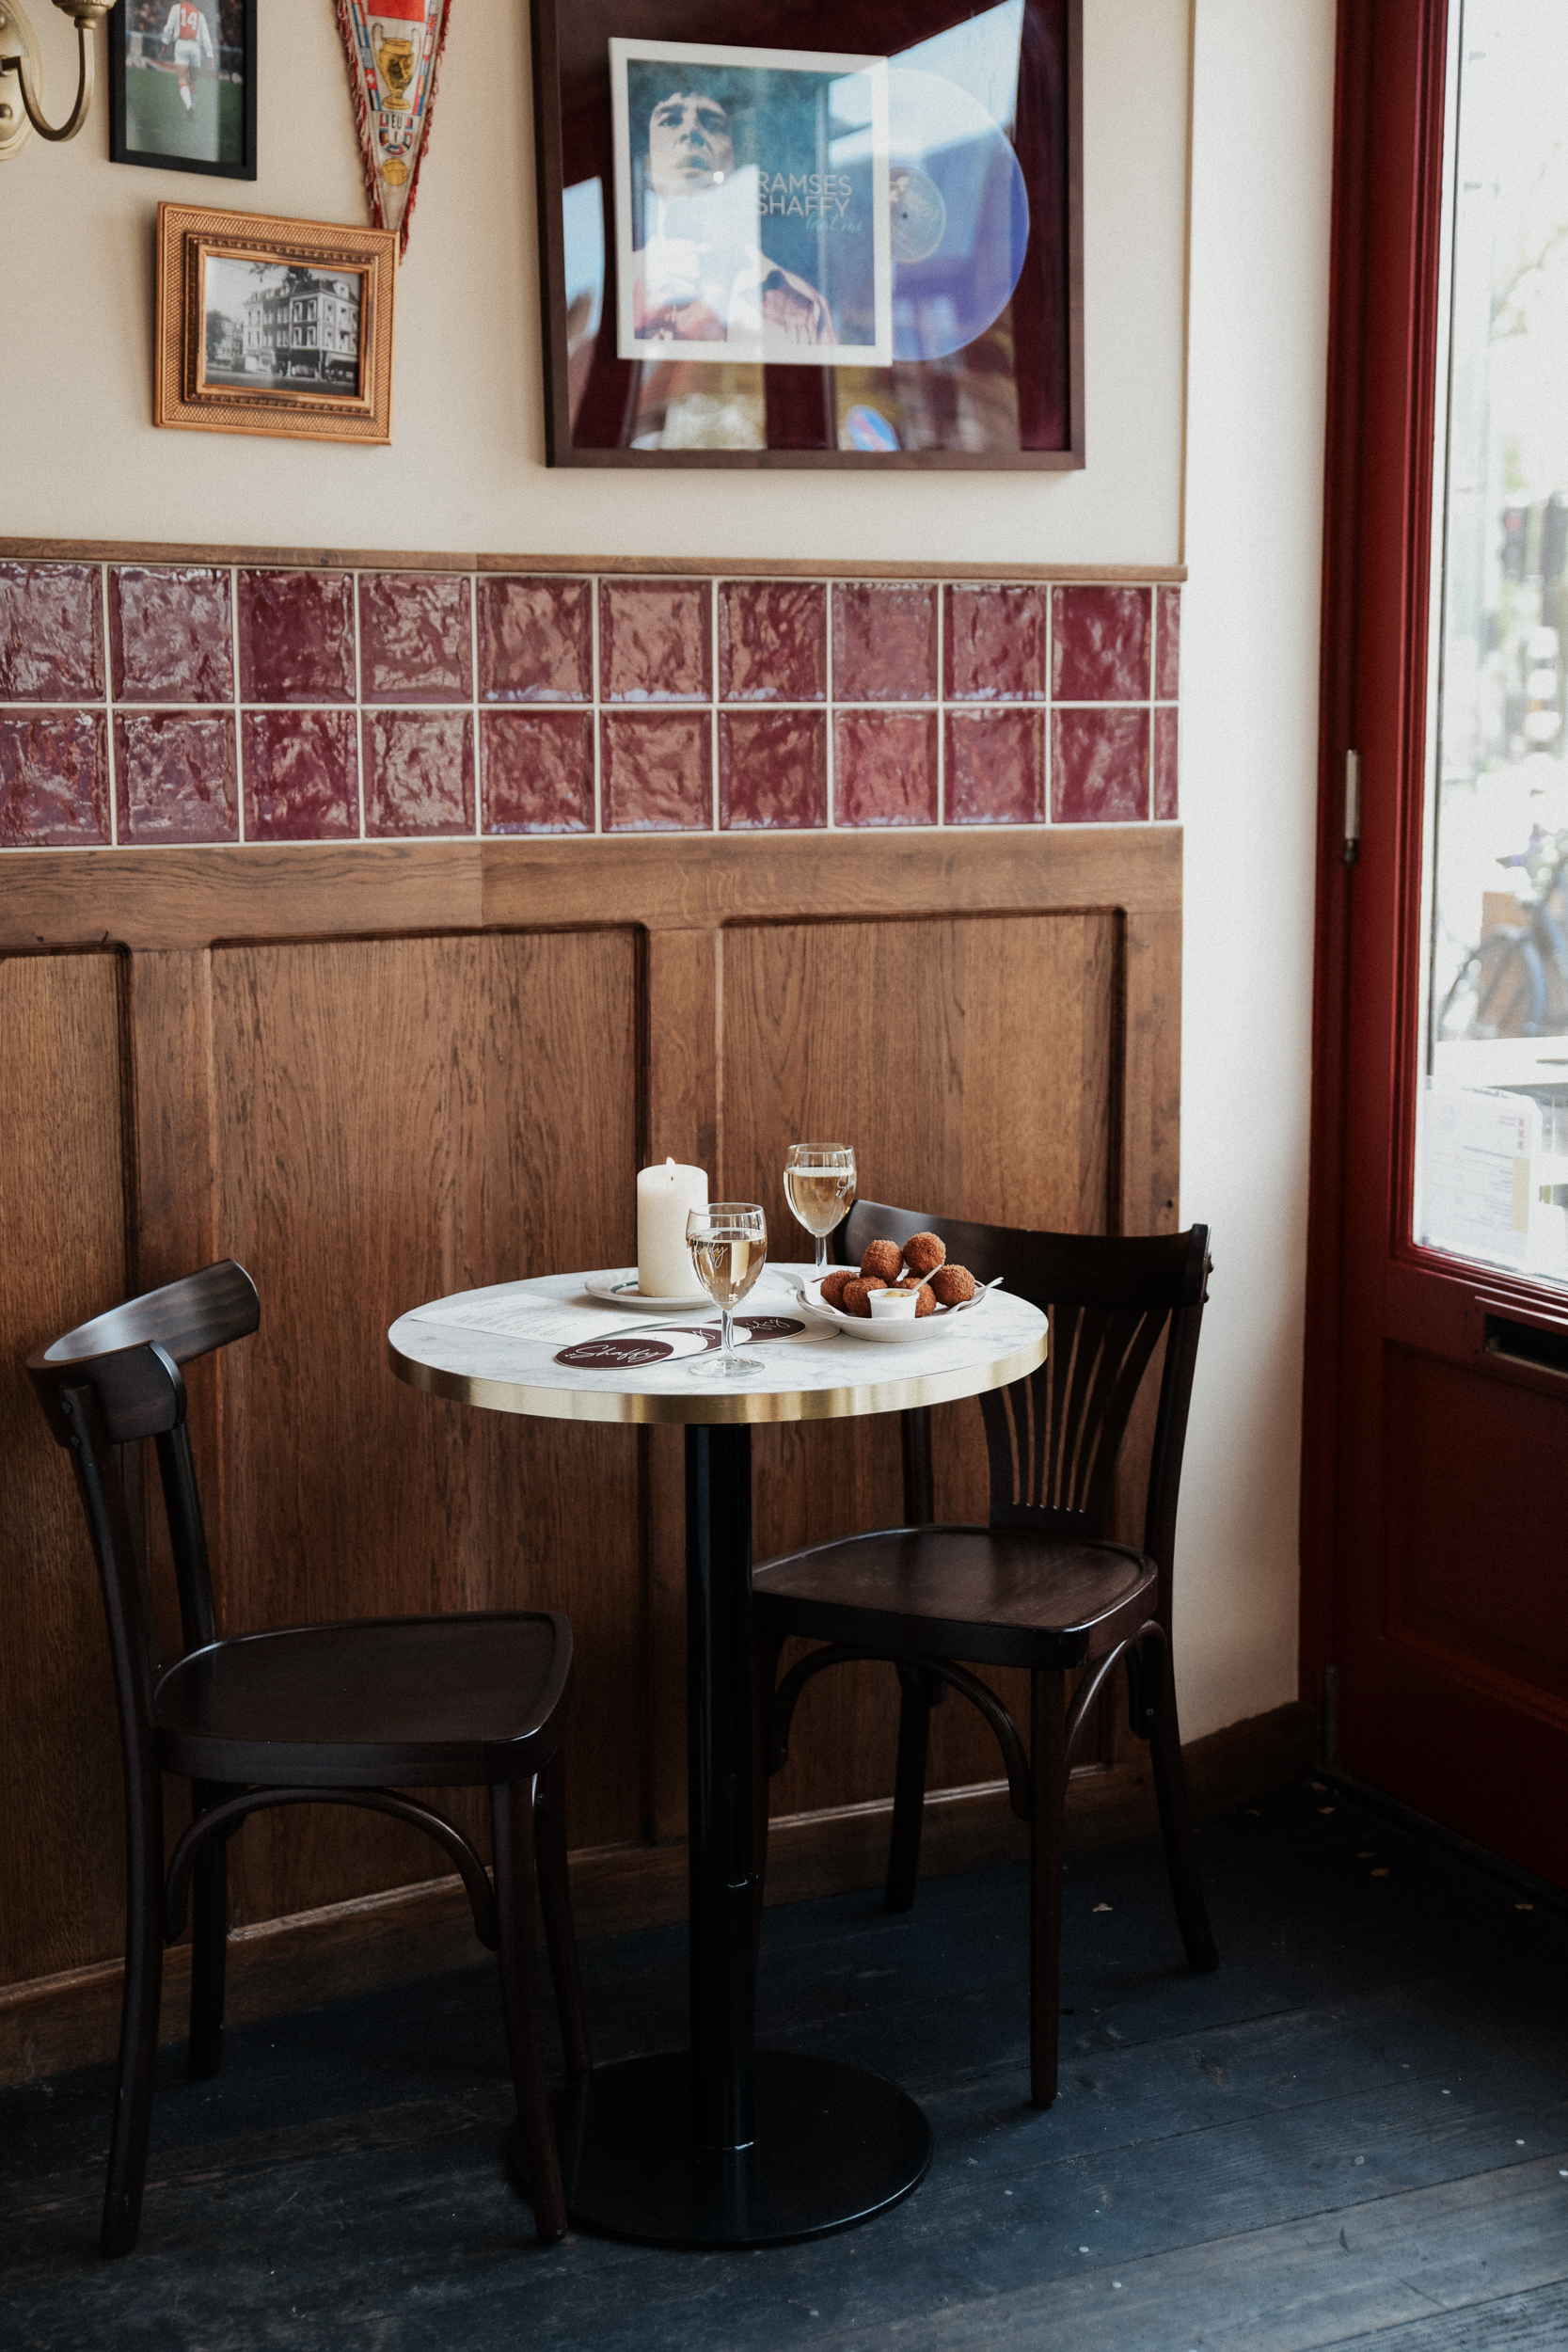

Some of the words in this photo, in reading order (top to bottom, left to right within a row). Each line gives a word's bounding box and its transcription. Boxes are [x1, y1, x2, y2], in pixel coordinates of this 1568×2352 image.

[181, 8, 198, 31] 14
[758, 171, 853, 198] RAMSES
[758, 193, 850, 218] SHAFFY
